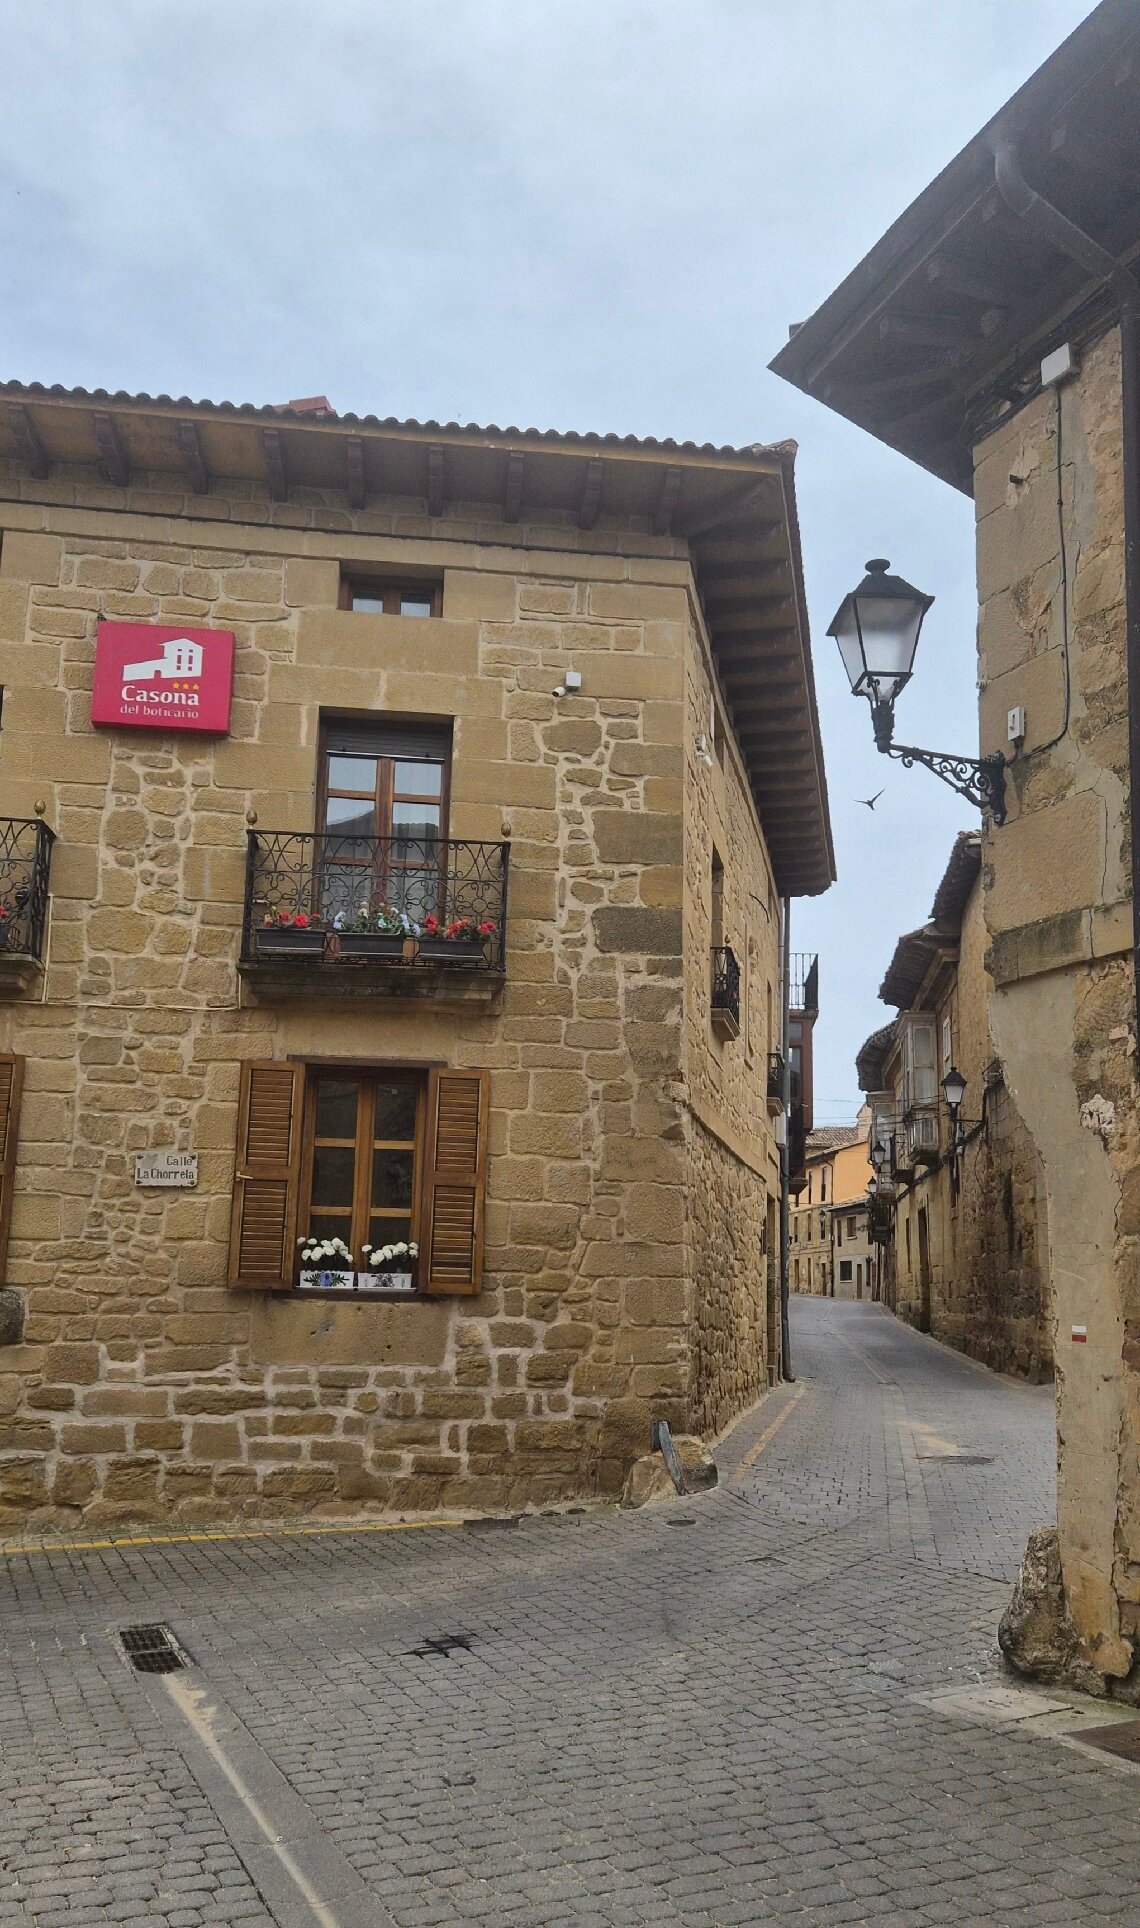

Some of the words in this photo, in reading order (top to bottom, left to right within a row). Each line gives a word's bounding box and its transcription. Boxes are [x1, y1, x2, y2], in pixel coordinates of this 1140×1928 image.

[121, 685, 199, 705] Casona
[120, 704, 139, 714] del
[143, 706, 199, 718] boticario
[166, 1155, 192, 1166] Calle
[137, 1168, 149, 1179] La
